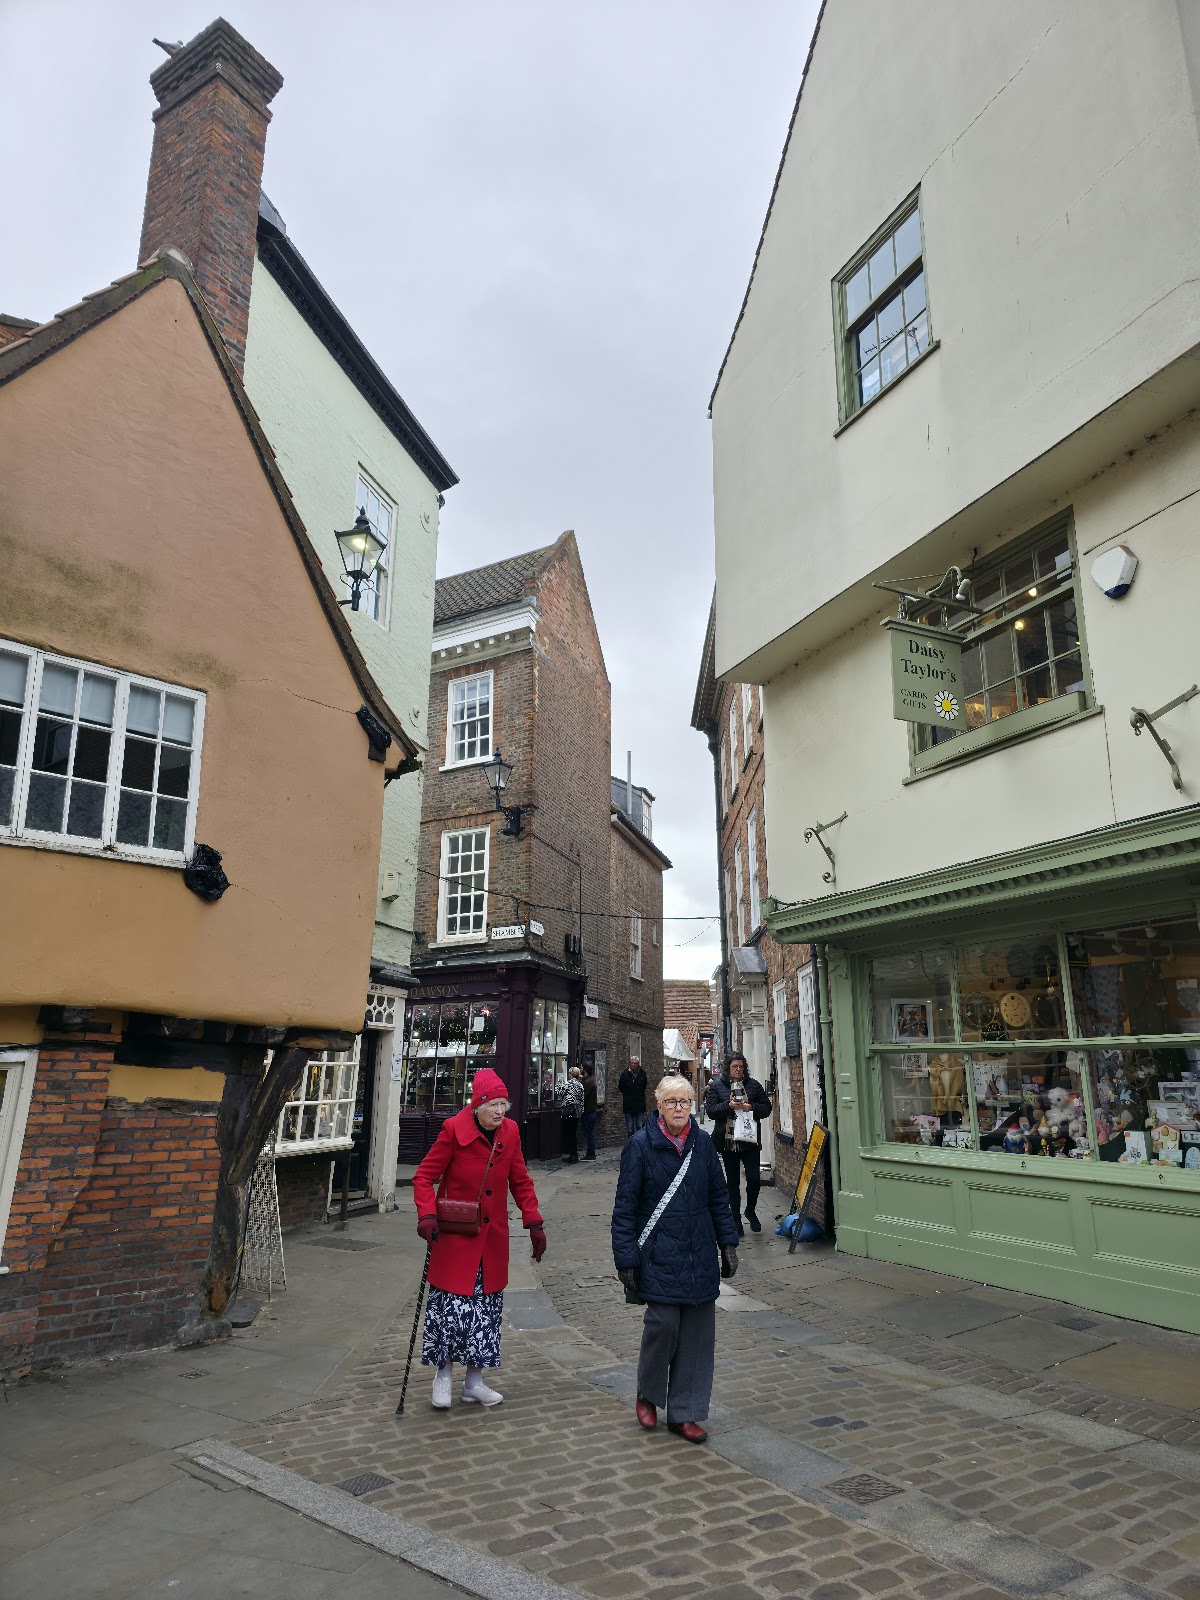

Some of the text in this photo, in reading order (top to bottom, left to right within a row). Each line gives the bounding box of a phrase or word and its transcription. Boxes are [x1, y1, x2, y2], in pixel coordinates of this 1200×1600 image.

[908, 639, 946, 663] Daisy
[901, 658, 956, 683] Taylor's
[900, 688, 928, 700] CARDS
[902, 698, 927, 710] GIFTS
[410, 985, 459, 998] DAWSON
